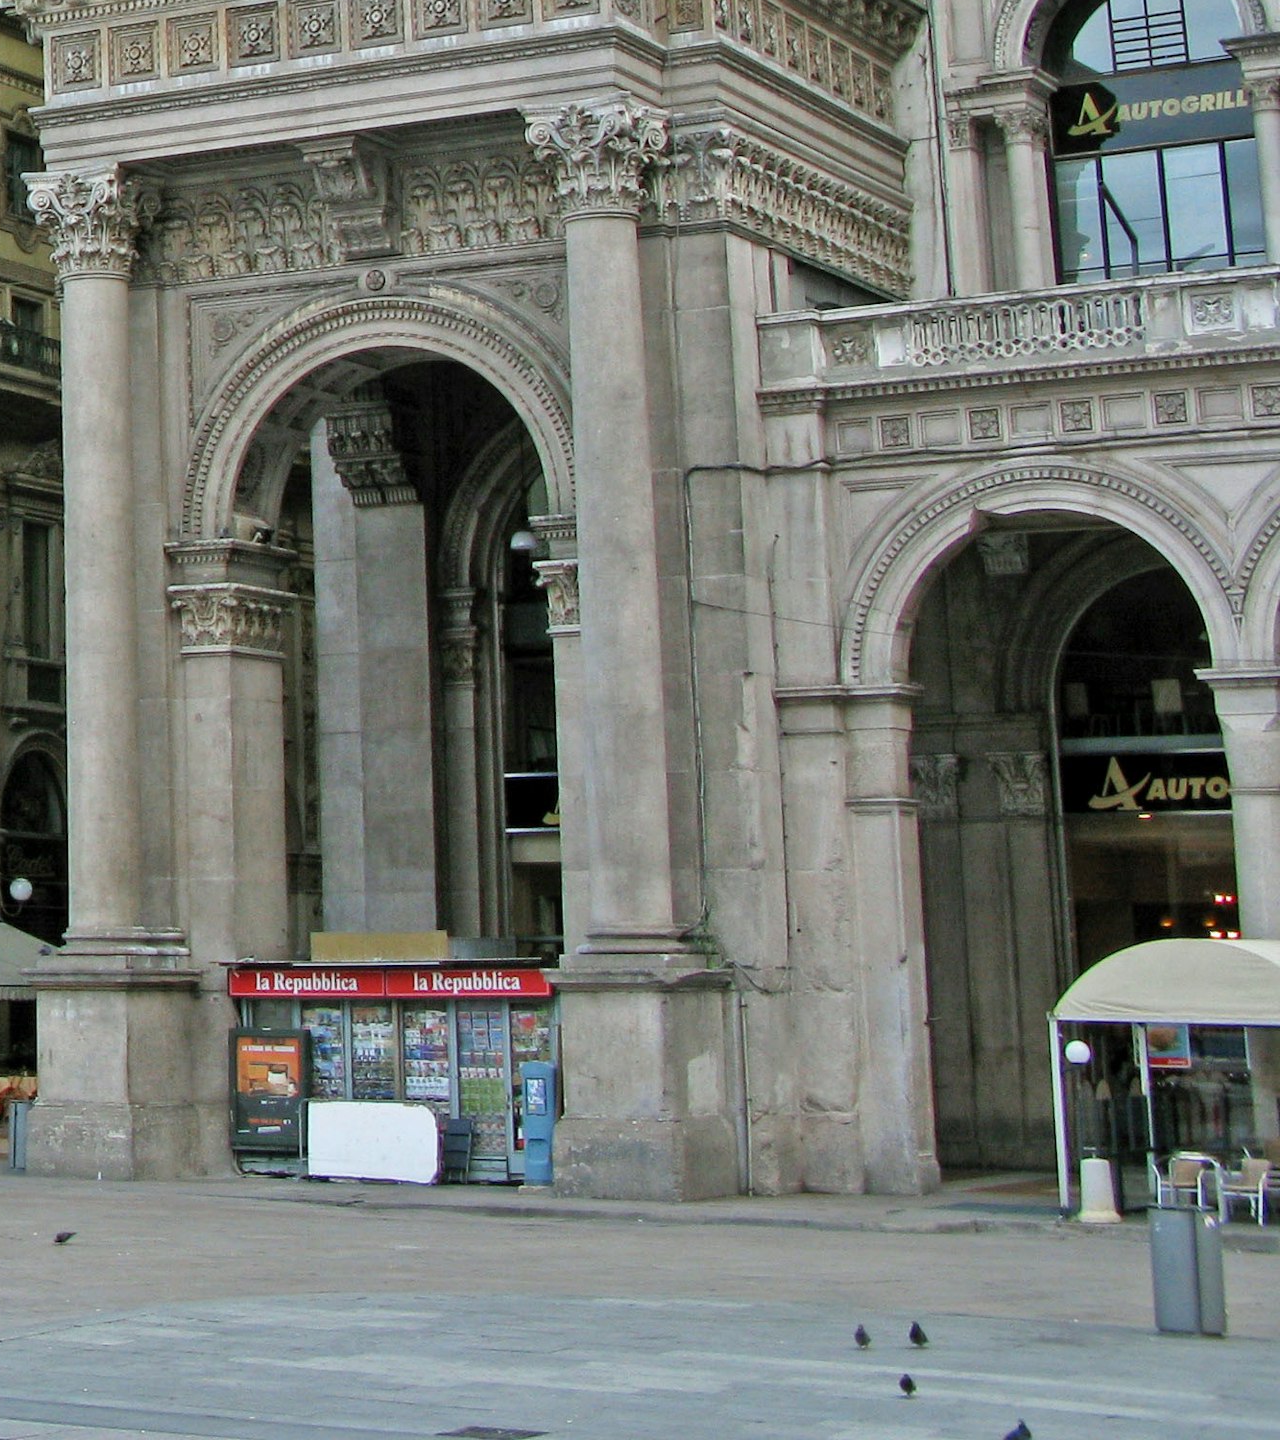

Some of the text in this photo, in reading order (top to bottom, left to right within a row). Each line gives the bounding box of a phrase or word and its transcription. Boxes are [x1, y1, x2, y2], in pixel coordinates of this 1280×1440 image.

[1115, 89, 1248, 122] AUTOGRILL
[1146, 776, 1229, 800] AUTO
[255, 971, 521, 994] la Repubblica la Repubblica
